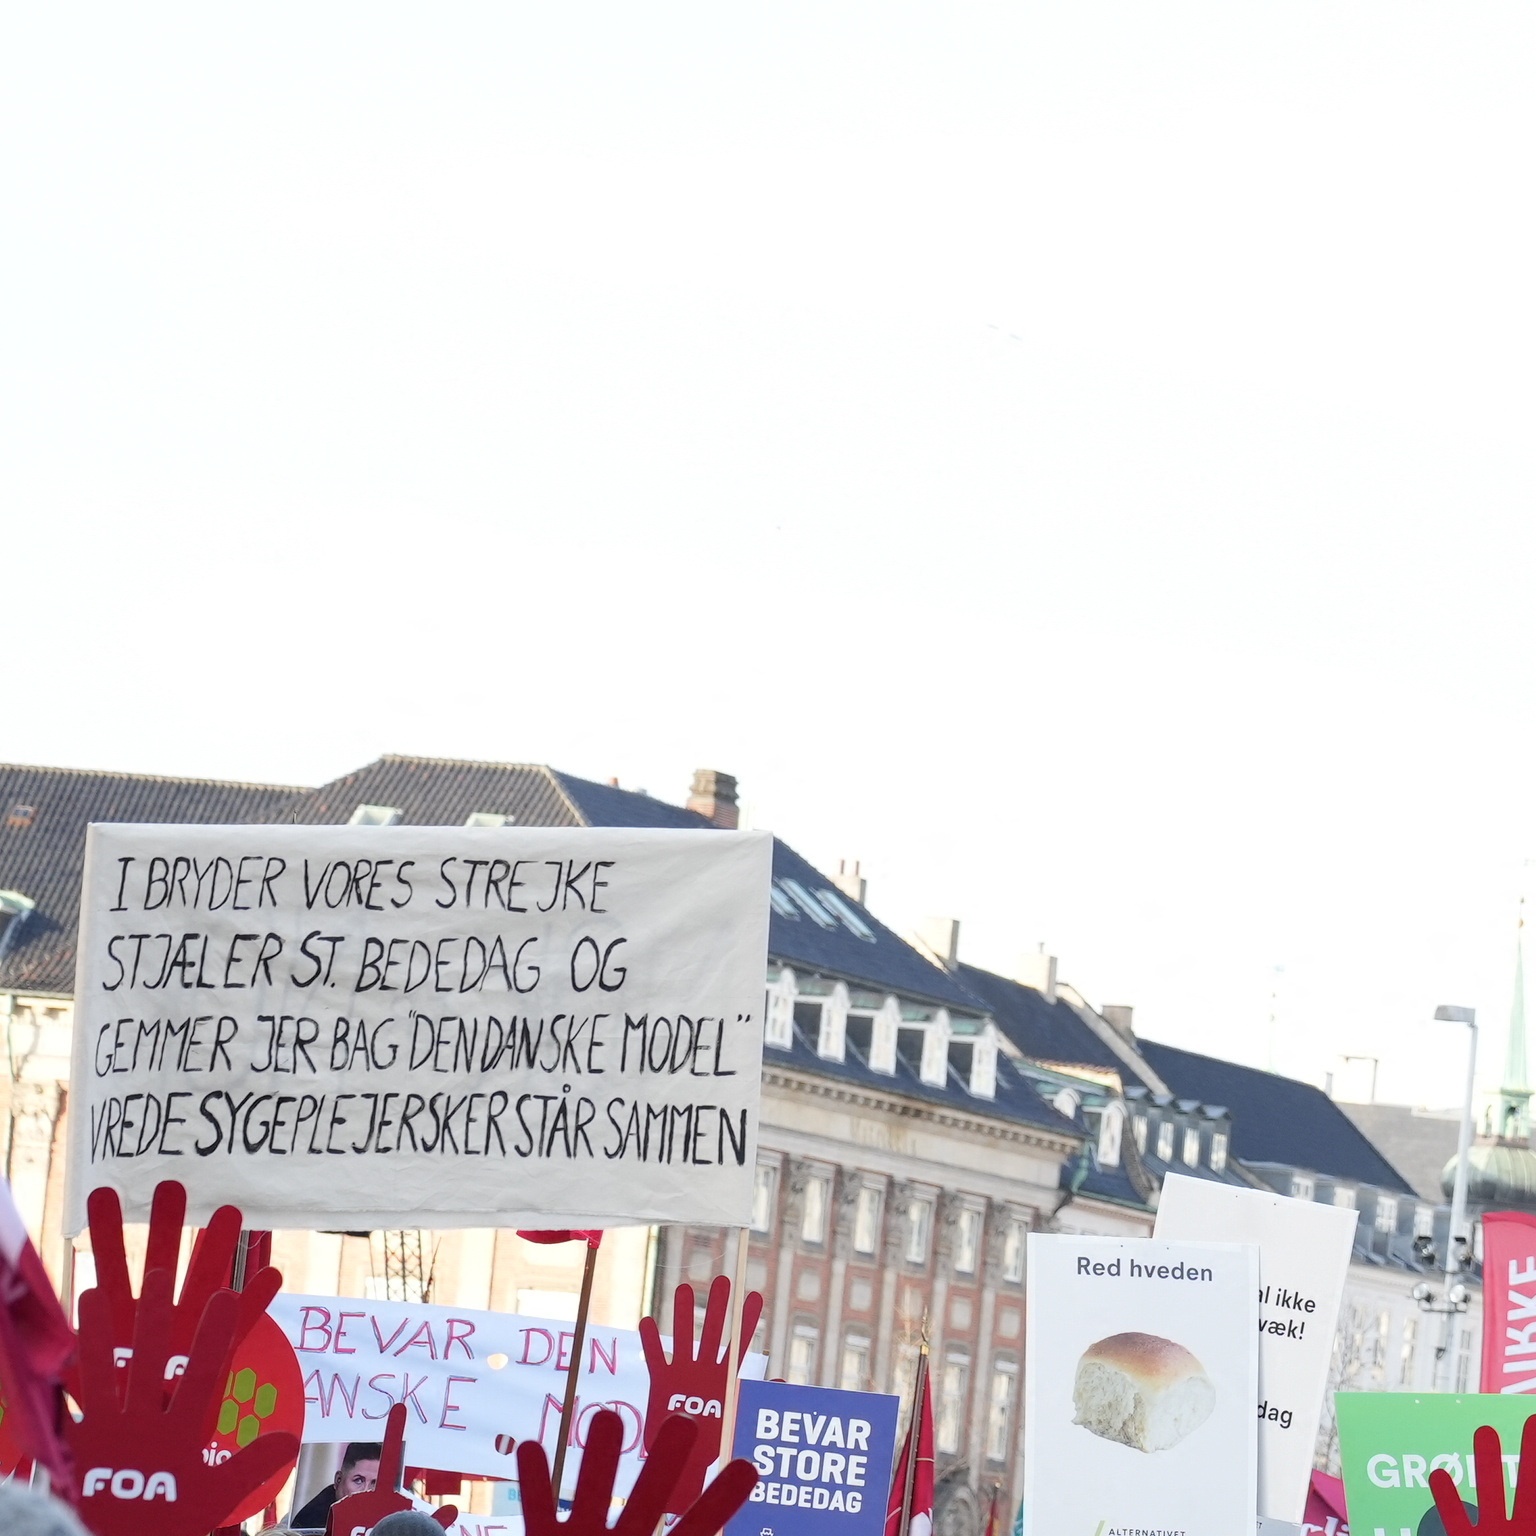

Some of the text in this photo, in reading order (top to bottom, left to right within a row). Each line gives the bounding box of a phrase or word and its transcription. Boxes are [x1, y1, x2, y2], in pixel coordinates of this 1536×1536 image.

[110, 857, 616, 913] I BRYDER VORES STREJKE
[103, 930, 627, 993] STJÆLER ST. BEDEDAG OG
[95, 1016, 238, 1077] GEMMER
[251, 1016, 320, 1074] JER
[330, 1017, 399, 1071] BAG
[480, 1014, 611, 1074] DANSKE
[91, 1083, 748, 1166] VREDE SYGEPLEJERSKER STÅR SAMMEN
[1076, 1257, 1214, 1282] Red hveden
[1275, 1287, 1316, 1313] ikke
[294, 1306, 617, 1375] BEVAR DEN
[304, 1369, 650, 1461] ANSKE MOD
[667, 1394, 722, 1419] FOA
[1257, 1400, 1293, 1429] dag
[756, 1408, 871, 1450] BEVAR
[82, 1467, 177, 1502] FOA
[752, 1444, 868, 1487] STORE
[1367, 1452, 1520, 1488] GRØT
[749, 1482, 863, 1514] BEDEDAG
